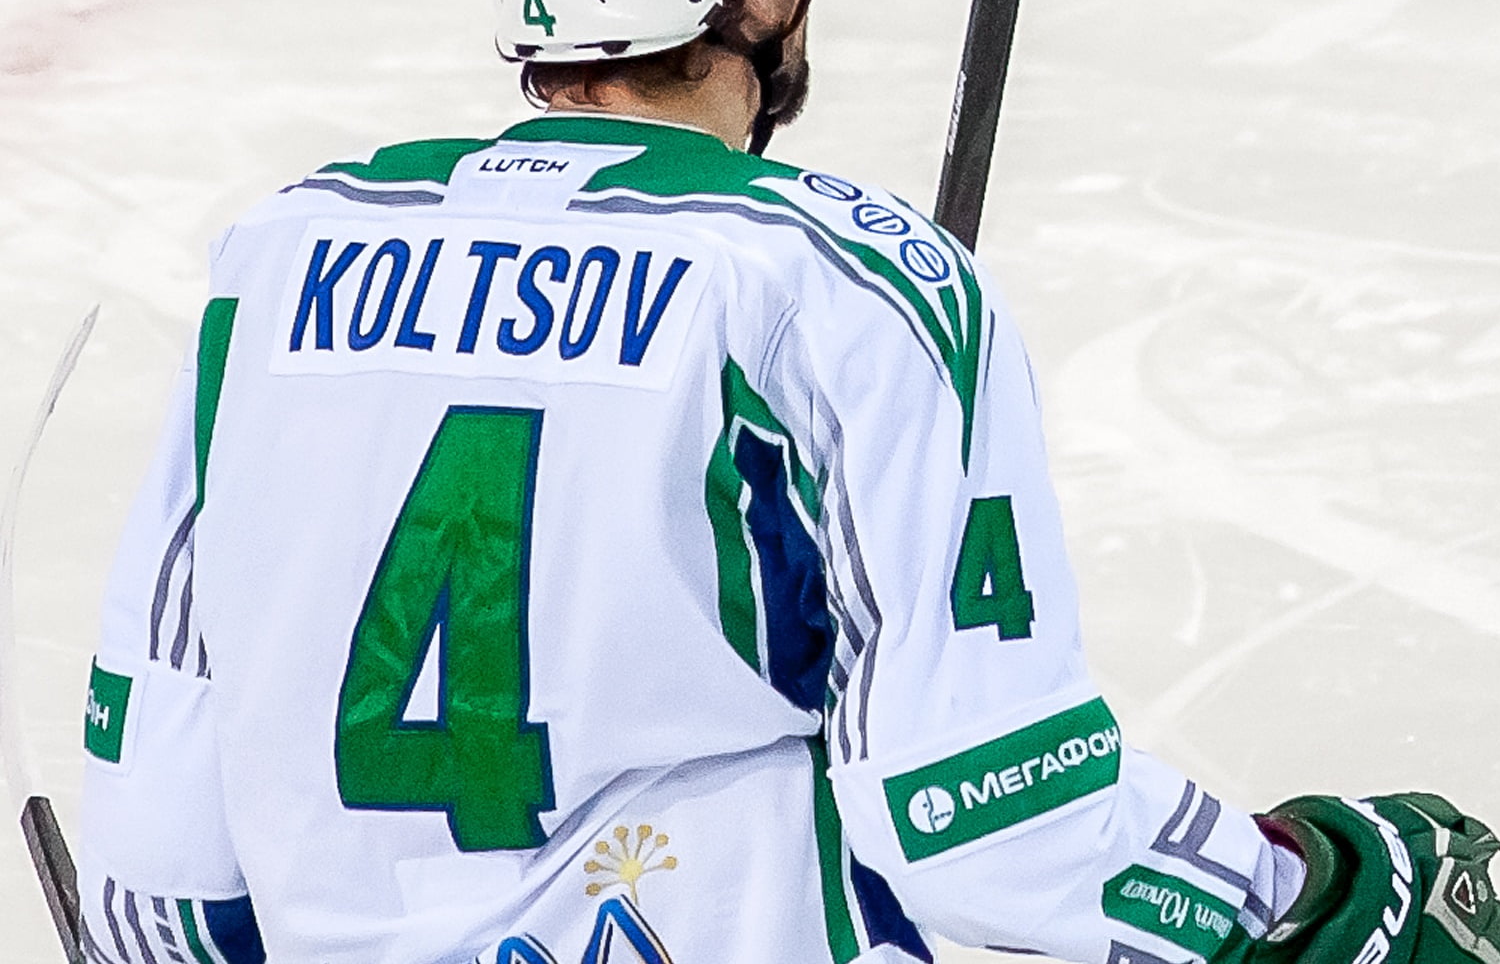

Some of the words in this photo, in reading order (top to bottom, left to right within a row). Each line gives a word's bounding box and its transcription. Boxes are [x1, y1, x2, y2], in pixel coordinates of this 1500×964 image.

[479, 158, 569, 173] LUTCH
[289, 237, 694, 367] KOLTSOV
[335, 405, 556, 853] 4
[950, 495, 1035, 642] 4
